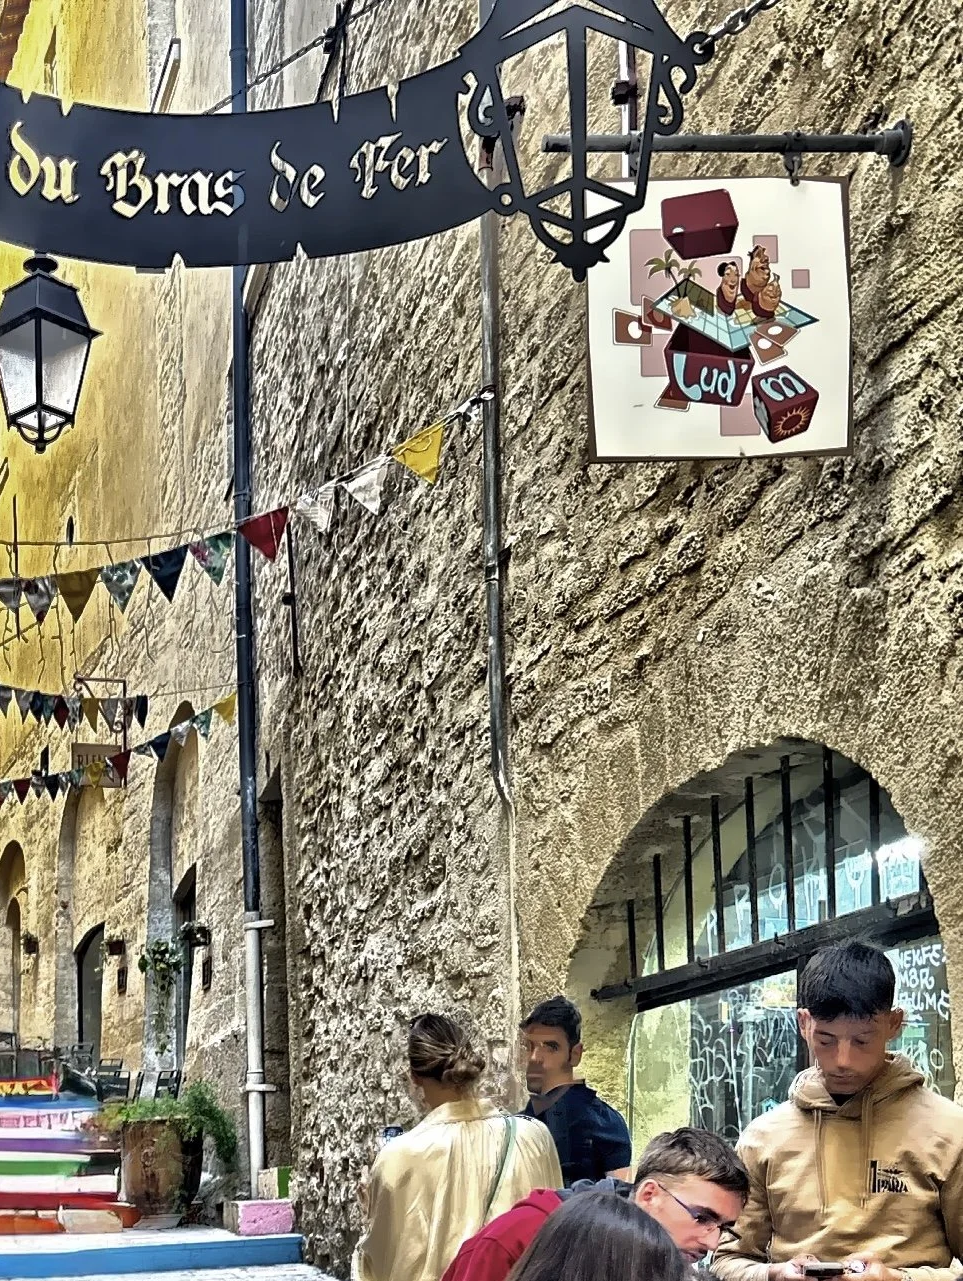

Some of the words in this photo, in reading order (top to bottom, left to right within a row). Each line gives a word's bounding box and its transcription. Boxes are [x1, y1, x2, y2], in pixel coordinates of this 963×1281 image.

[7, 120, 81, 205] du
[101, 149, 246, 221] Bras
[269, 139, 327, 214] de
[349, 131, 449, 201] Fer
